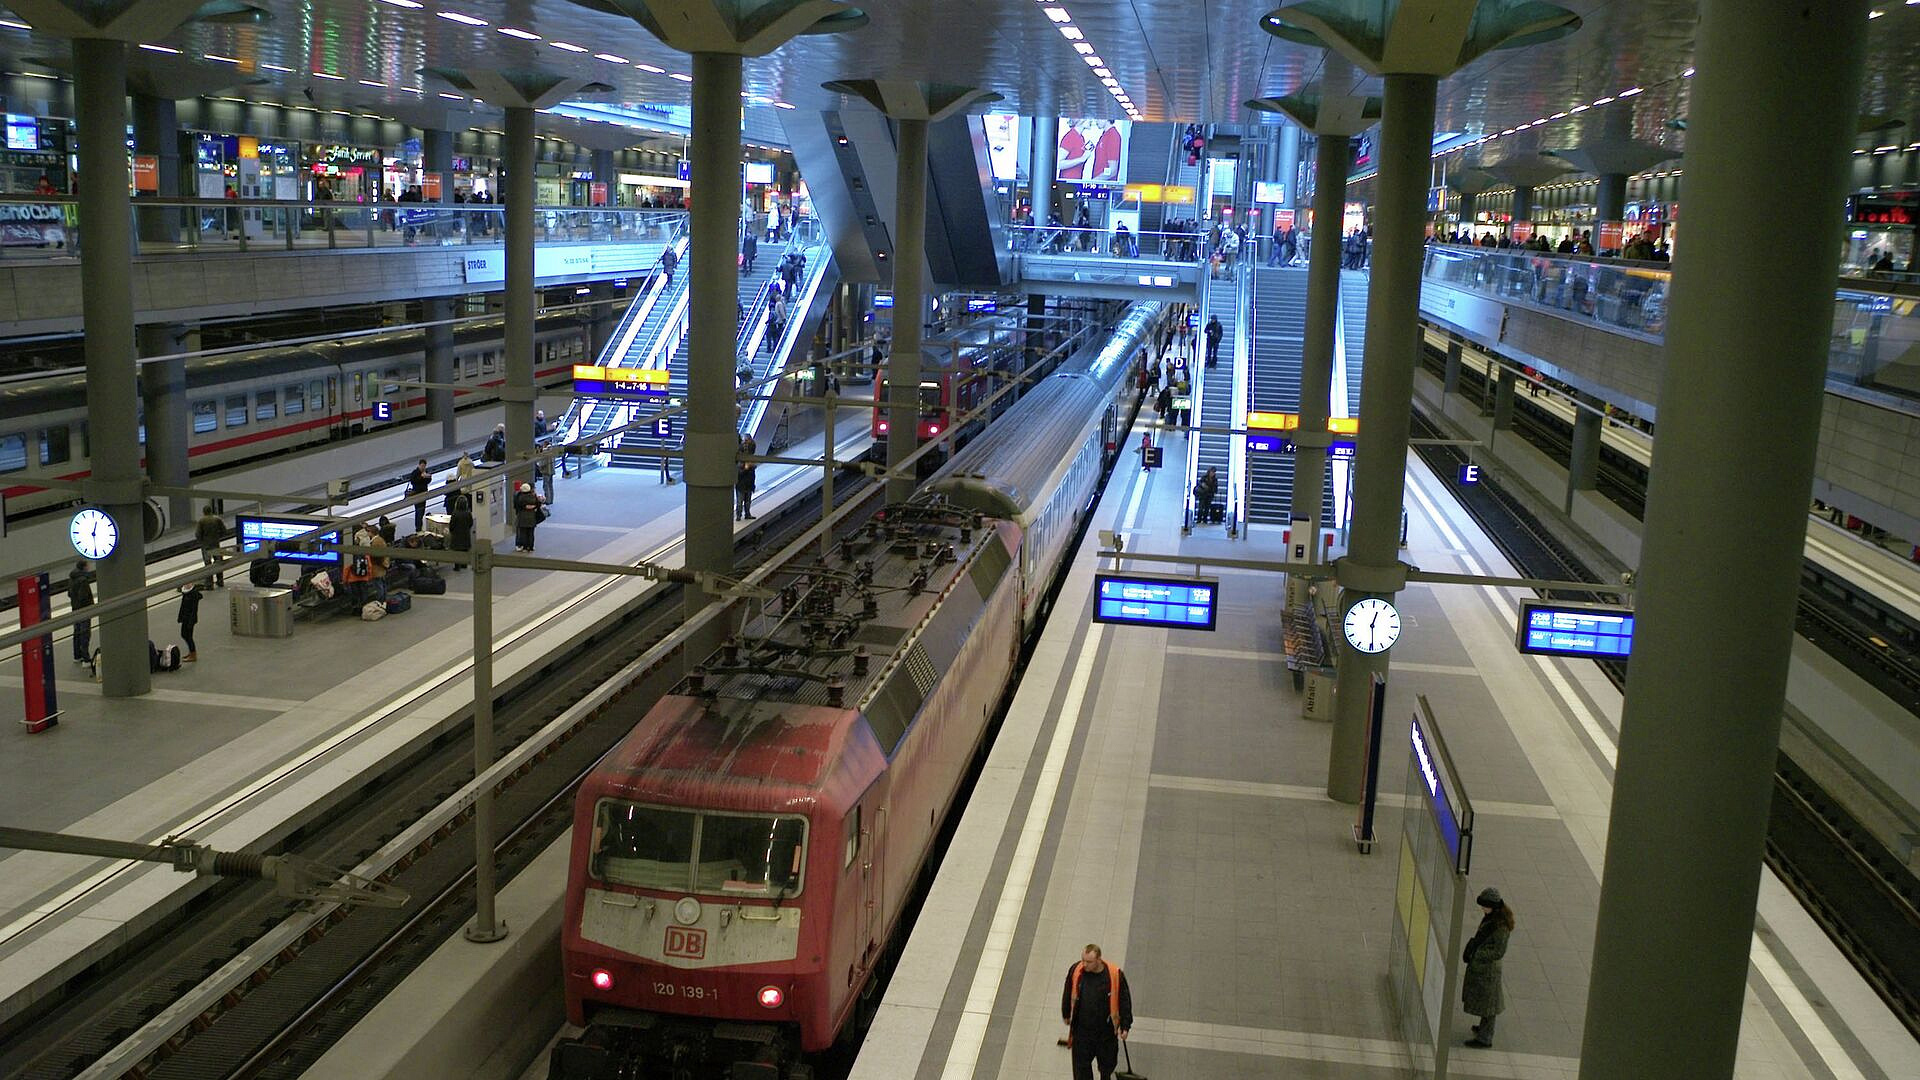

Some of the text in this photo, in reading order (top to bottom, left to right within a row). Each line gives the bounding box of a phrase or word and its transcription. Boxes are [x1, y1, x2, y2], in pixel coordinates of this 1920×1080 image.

[1175, 357, 1184, 368] D
[378, 402, 389, 418] E
[658, 418, 669, 435] E
[1144, 447, 1155, 463] E
[1466, 465, 1479, 482] E
[668, 930, 701, 955] DB
[653, 982, 719, 1000] 120 139-1
